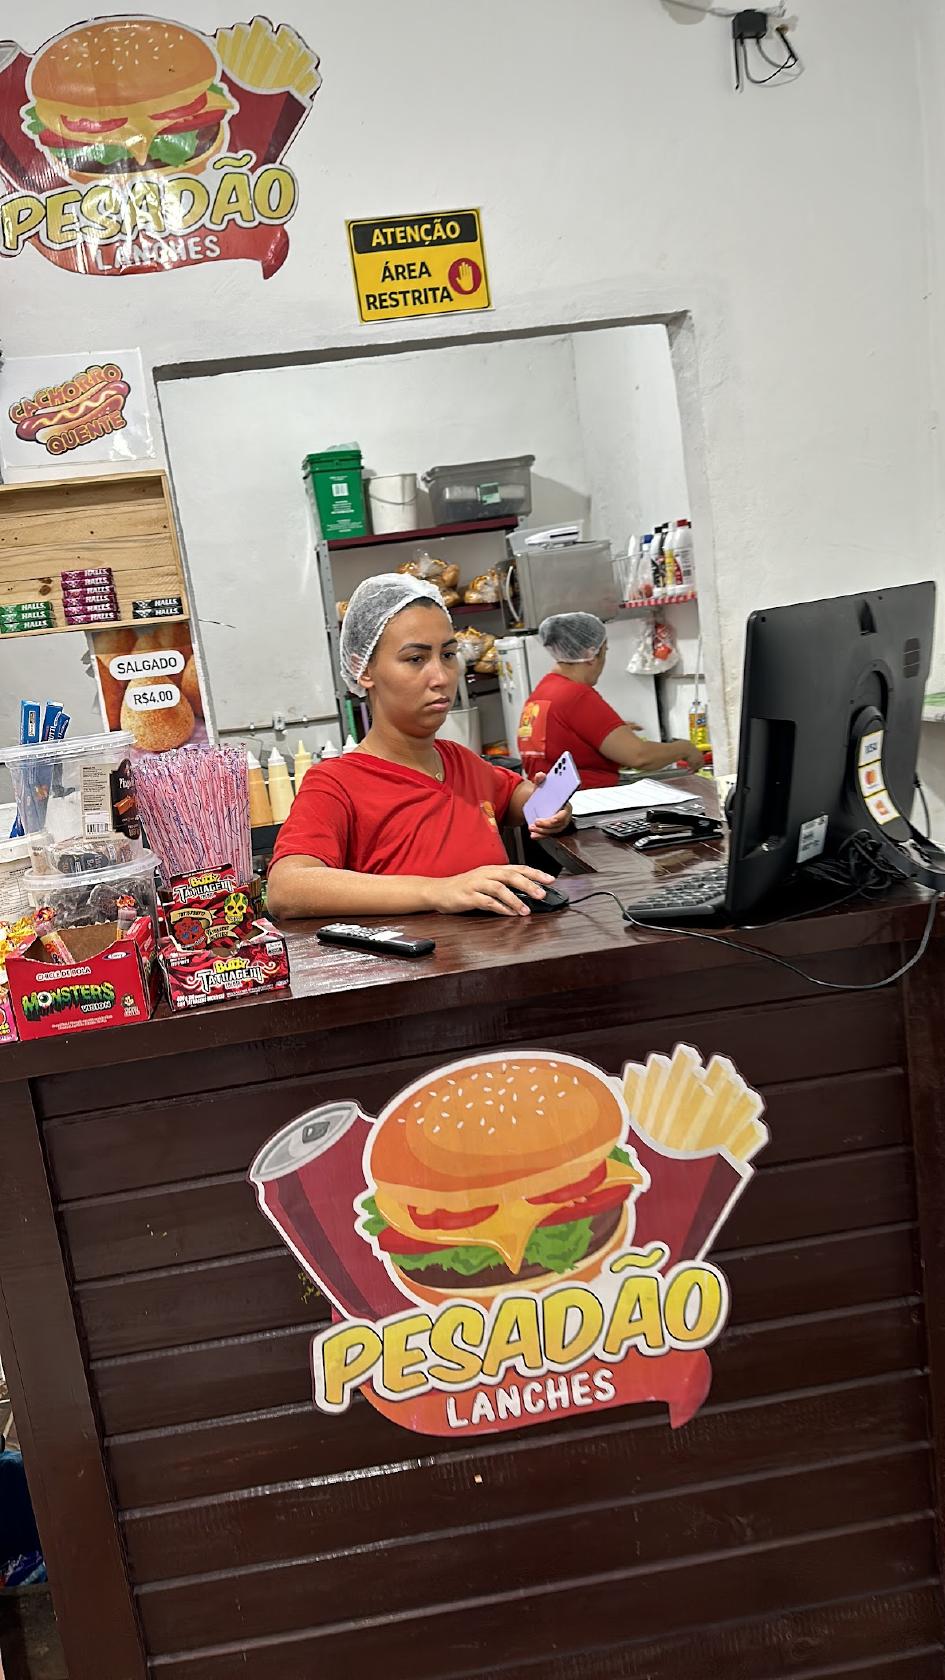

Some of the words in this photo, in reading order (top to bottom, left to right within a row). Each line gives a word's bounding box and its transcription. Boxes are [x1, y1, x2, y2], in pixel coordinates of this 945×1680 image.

[1, 154, 295, 250] PESADÃO
[371, 218, 461, 247] ATENÇÃO
[381, 261, 432, 283] ÁREA
[365, 286, 454, 311] RESTRITA
[9, 363, 123, 424] CACHORRO
[46, 409, 127, 455] QUENTE
[21, 601, 46, 612] HALLS
[21, 611, 46, 621] HALLS
[117, 656, 177, 674] SALGADO
[133, 690, 173, 705] R$4.00
[323, 1248, 721, 1404] PESADÃO
[446, 1371, 616, 1428] LANCHES
